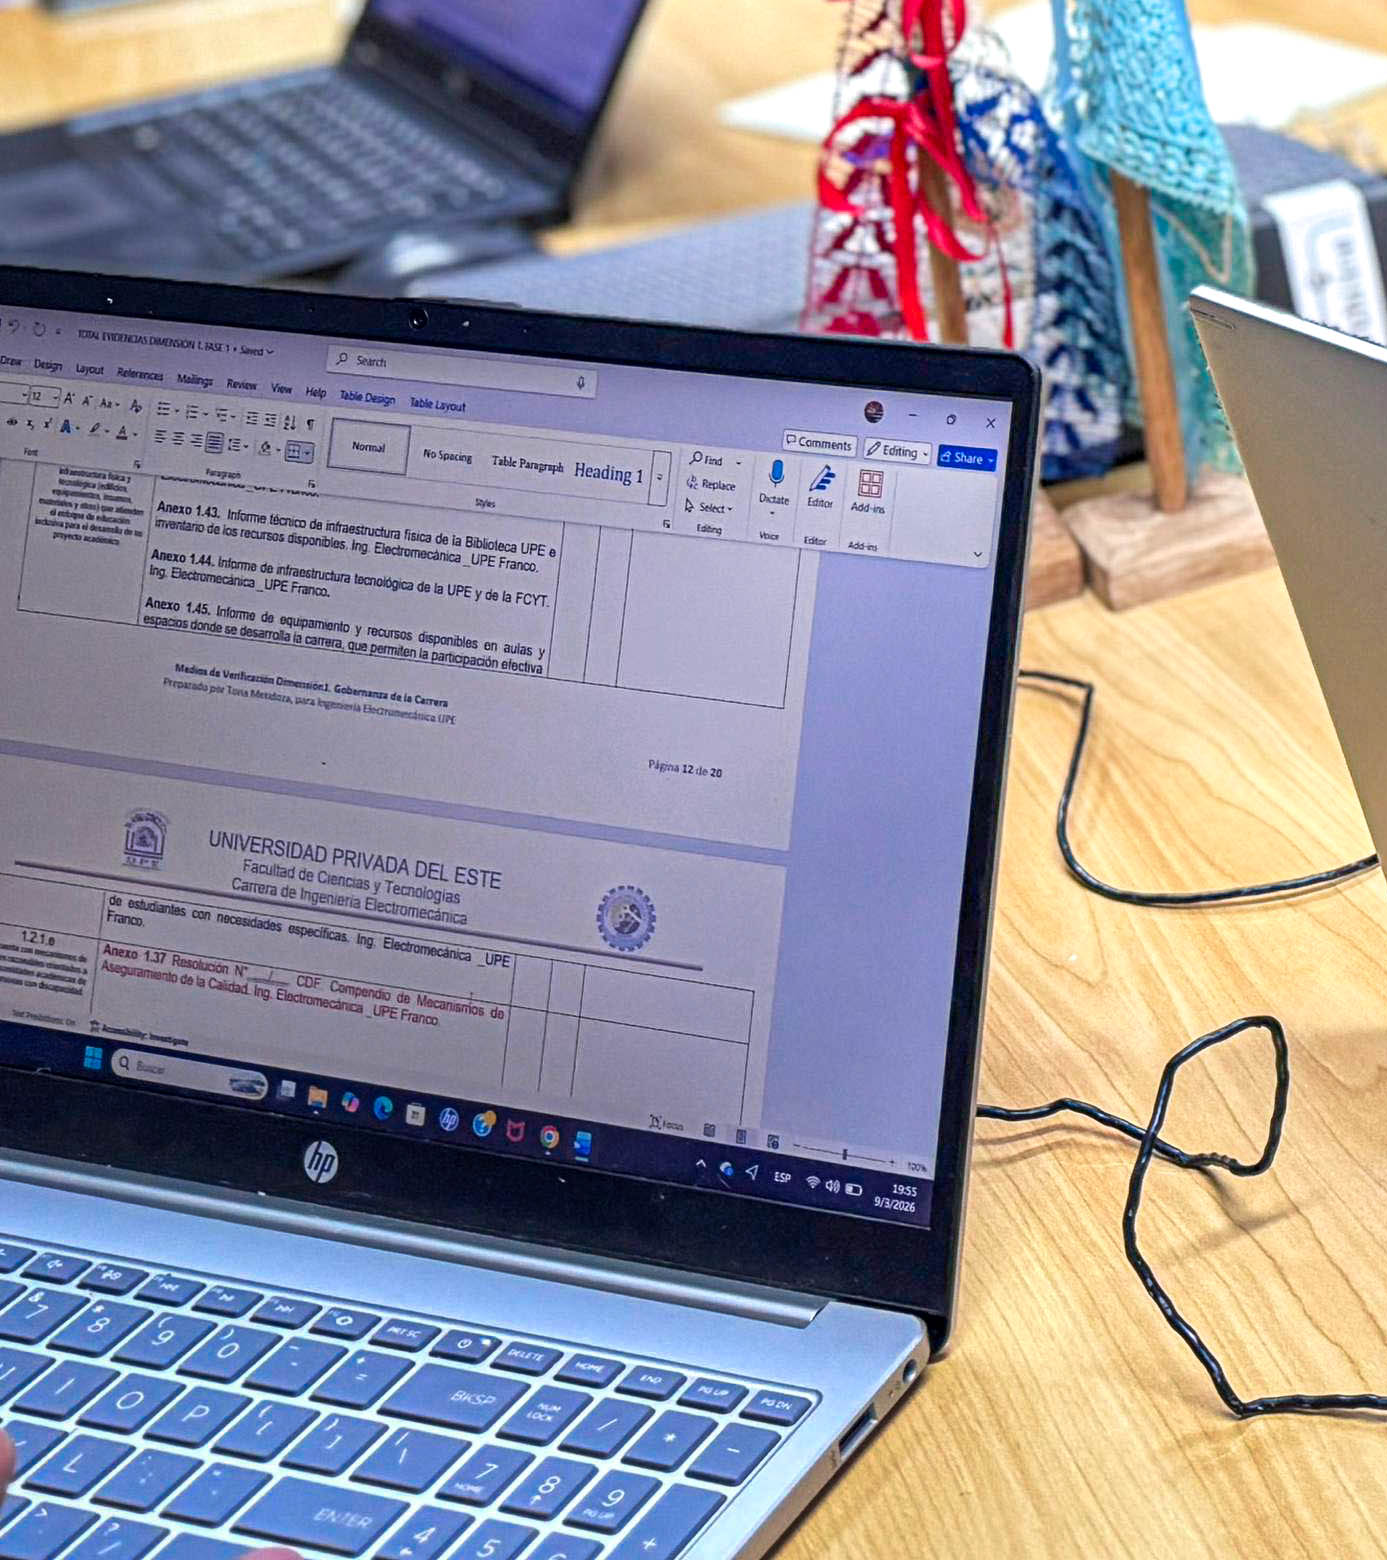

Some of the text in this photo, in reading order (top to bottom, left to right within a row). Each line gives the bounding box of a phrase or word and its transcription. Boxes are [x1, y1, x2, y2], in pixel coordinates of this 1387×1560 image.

[356, 355, 387, 369] Search
[34, 358, 63, 372] Design
[76, 363, 104, 376] Layout
[117, 367, 163, 382] References
[177, 373, 213, 388] Mailings
[227, 378, 257, 391] Review
[271, 383, 292, 395] View
[305, 387, 327, 399] Help
[340, 390, 363, 402] Table
[365, 393, 396, 406] Design
[410, 397, 433, 409] Table
[435, 400, 466, 413] Layout
[352, 440, 386, 454] Normal
[798, 437, 852, 452] Comments
[883, 445, 918, 460] Editing
[423, 448, 472, 465] No Spacing
[492, 455, 564, 474] Table Paragraph
[704, 456, 723, 467] Find
[954, 452, 983, 465] Share
[575, 462, 632, 486] Heading
[701, 479, 736, 492] Replace
[759, 493, 790, 506] Dictate
[807, 496, 833, 509] Editor
[699, 502, 725, 515] Select
[851, 502, 886, 515] Add-ins
[157, 501, 557, 558] Anexo 1.43. Informe técnico de infraestructura de la Biblioteca UPE e
[696, 523, 722, 537] Editing
[155, 518, 539, 573] inventario de los recursos disponibles. Electromecánica Franco.
[149, 565, 330, 598] Ing. Electromecánica Franco.
[151, 549, 550, 608] Anexo 1.44. Informe de infraestructura tecnológica de la UPE de la FCYT.
[145, 597, 533, 656] Anexo 1.45. Informe de equipamiento recursos disponibles en aulas
[143, 614, 543, 675] espacios donde se desarrolla que permiten la participación efectiva
[414, 694, 449, 708] Carrera
[682, 764, 723, 778] 12 20
[209, 830, 503, 890] UNIVERSIDAD PRIVADA DEL ESTE
[243, 859, 295, 879] Facultad
[299, 868, 314, 882] de
[318, 870, 370, 890] Ciencias
[374, 881, 382, 895] y
[232, 877, 278, 896] Carrera
[281, 884, 297, 899] de
[365, 897, 468, 925] Electromecánica
[106, 910, 145, 927] Franco.
[109, 895, 472, 961] de estudiantes con necesidades Electromecánica
[101, 960, 363, 1014] Aseguramiento de Ing. Electromecánica
[103, 943, 505, 1020] Anexo 1.37 Resolución CDF Compendio de Mecanismos de
[304, 1141, 339, 1184] hp
[773, 1171, 792, 1184] ESP
[892, 1184, 918, 1197] 19:55
[874, 1195, 916, 1213] 9/3/2026
[507, 1348, 545, 1362] DELETE
[313, 1507, 373, 1529] ENTER
